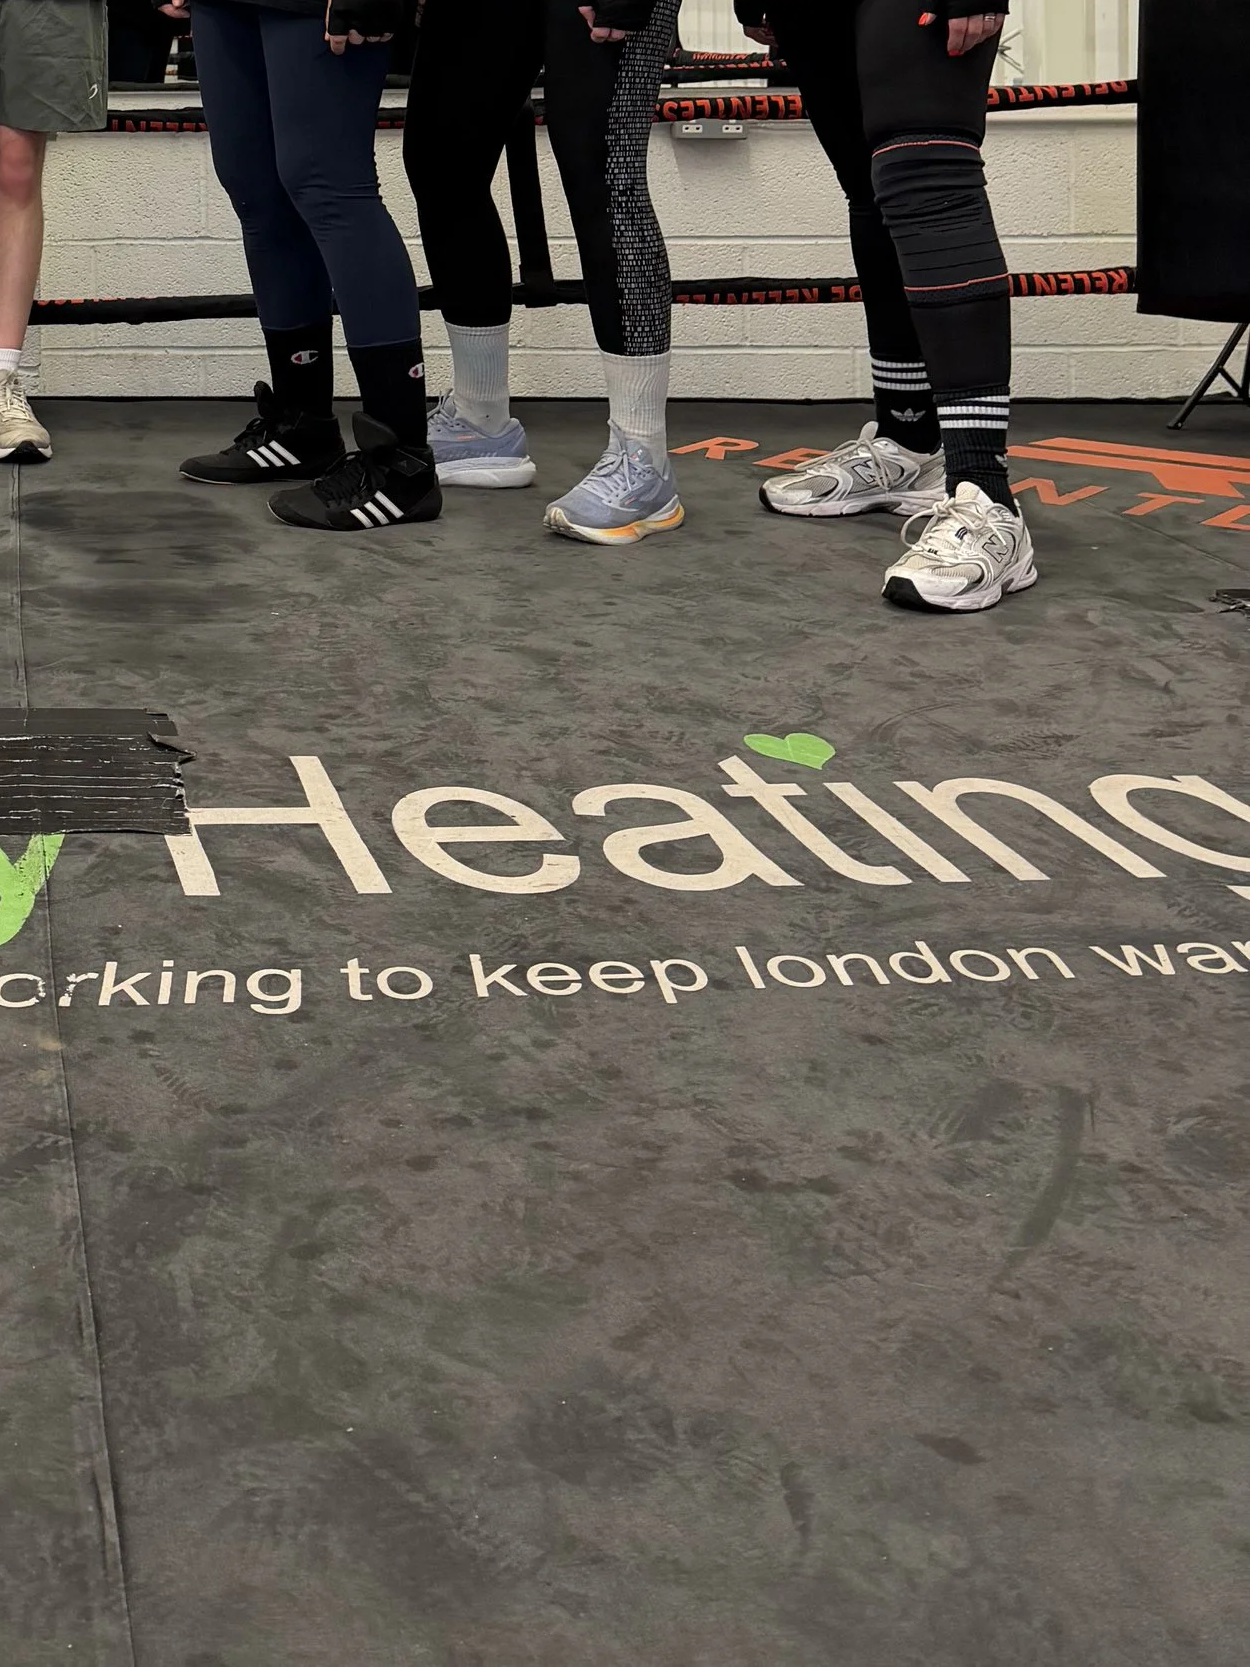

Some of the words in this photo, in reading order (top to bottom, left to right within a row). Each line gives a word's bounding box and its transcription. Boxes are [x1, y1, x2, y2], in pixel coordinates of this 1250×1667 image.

[340, 958, 434, 1001] to
[469, 953, 709, 1004] keep
[734, 941, 1076, 989] london
[1088, 940, 1250, 976] wa
